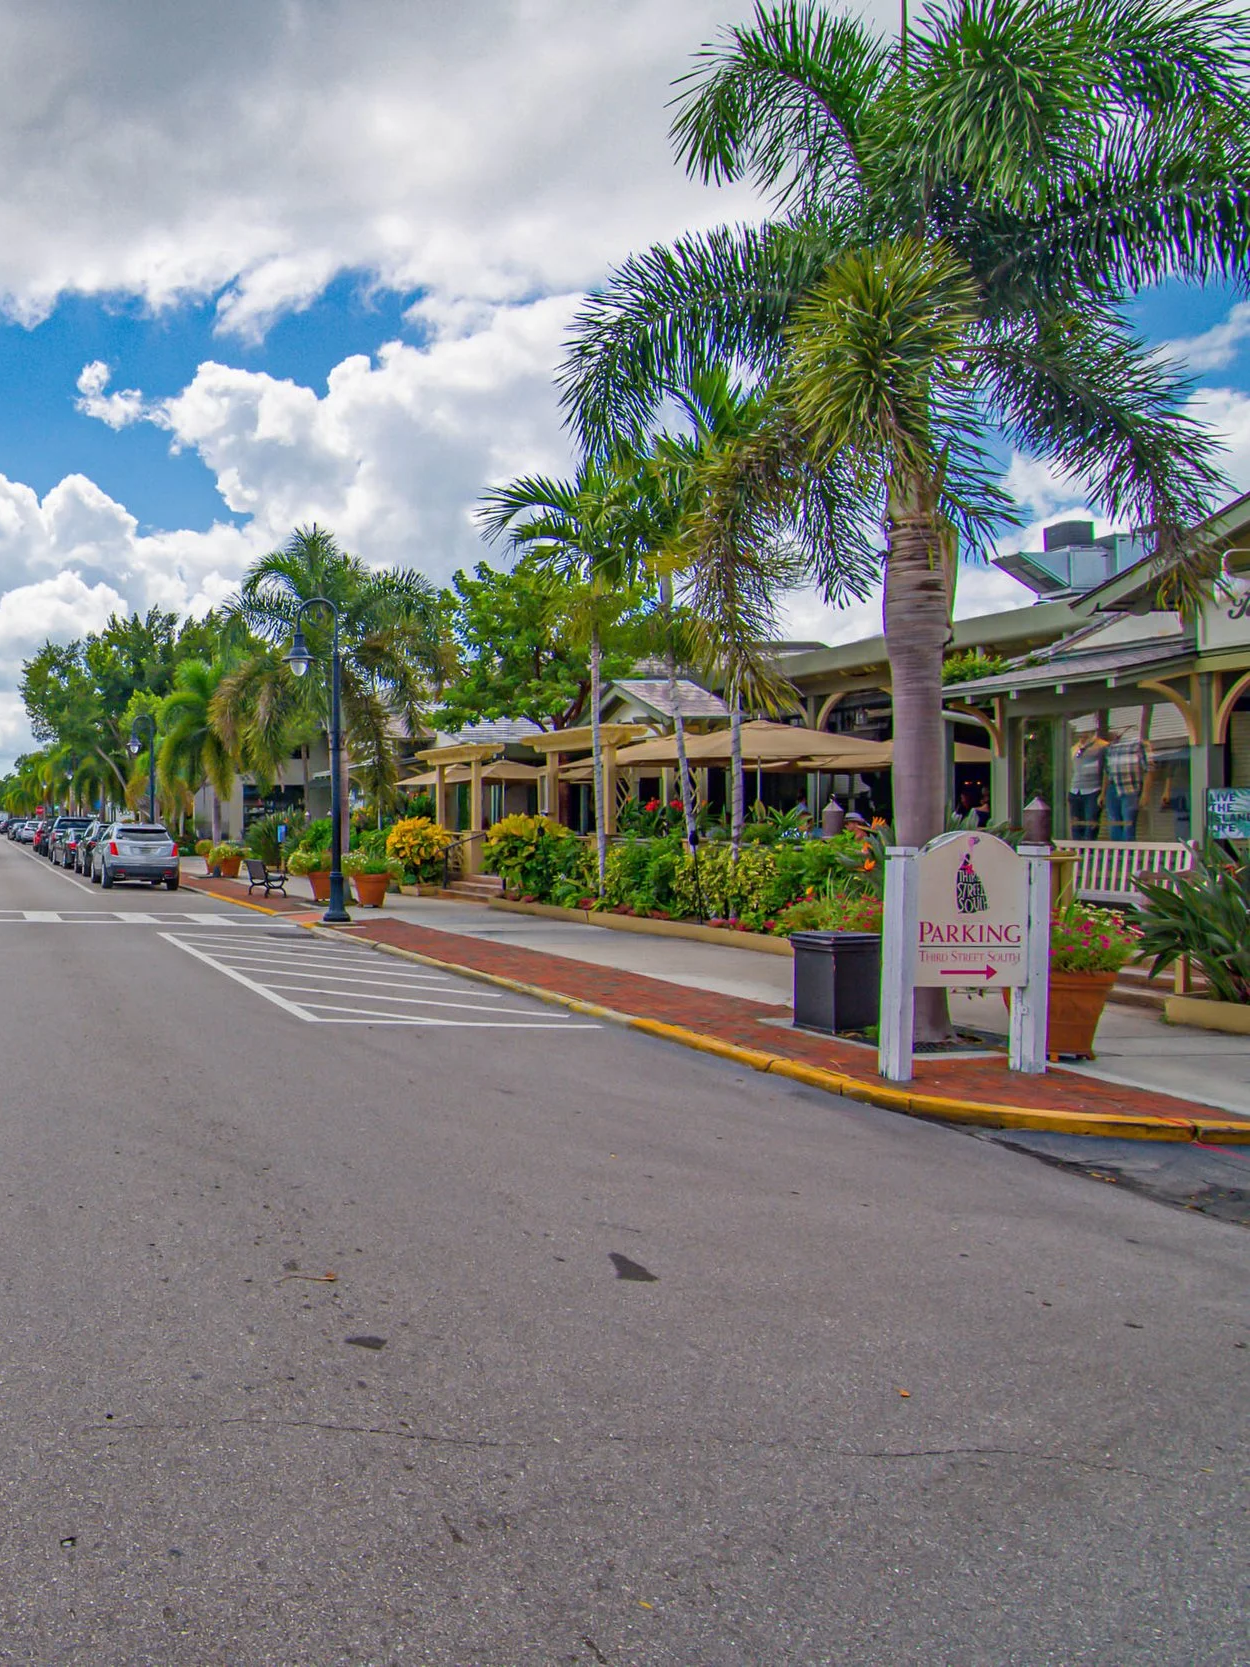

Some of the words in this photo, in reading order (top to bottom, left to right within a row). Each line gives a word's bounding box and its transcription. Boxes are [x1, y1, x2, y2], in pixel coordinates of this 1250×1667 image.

[1210, 793, 1236, 802] LIVE
[1209, 803, 1234, 813] THE
[919, 921, 1021, 943] PARKING
[918, 950, 949, 962] THIRD
[951, 950, 985, 962] STREET
[987, 950, 1021, 964] SOUTH
